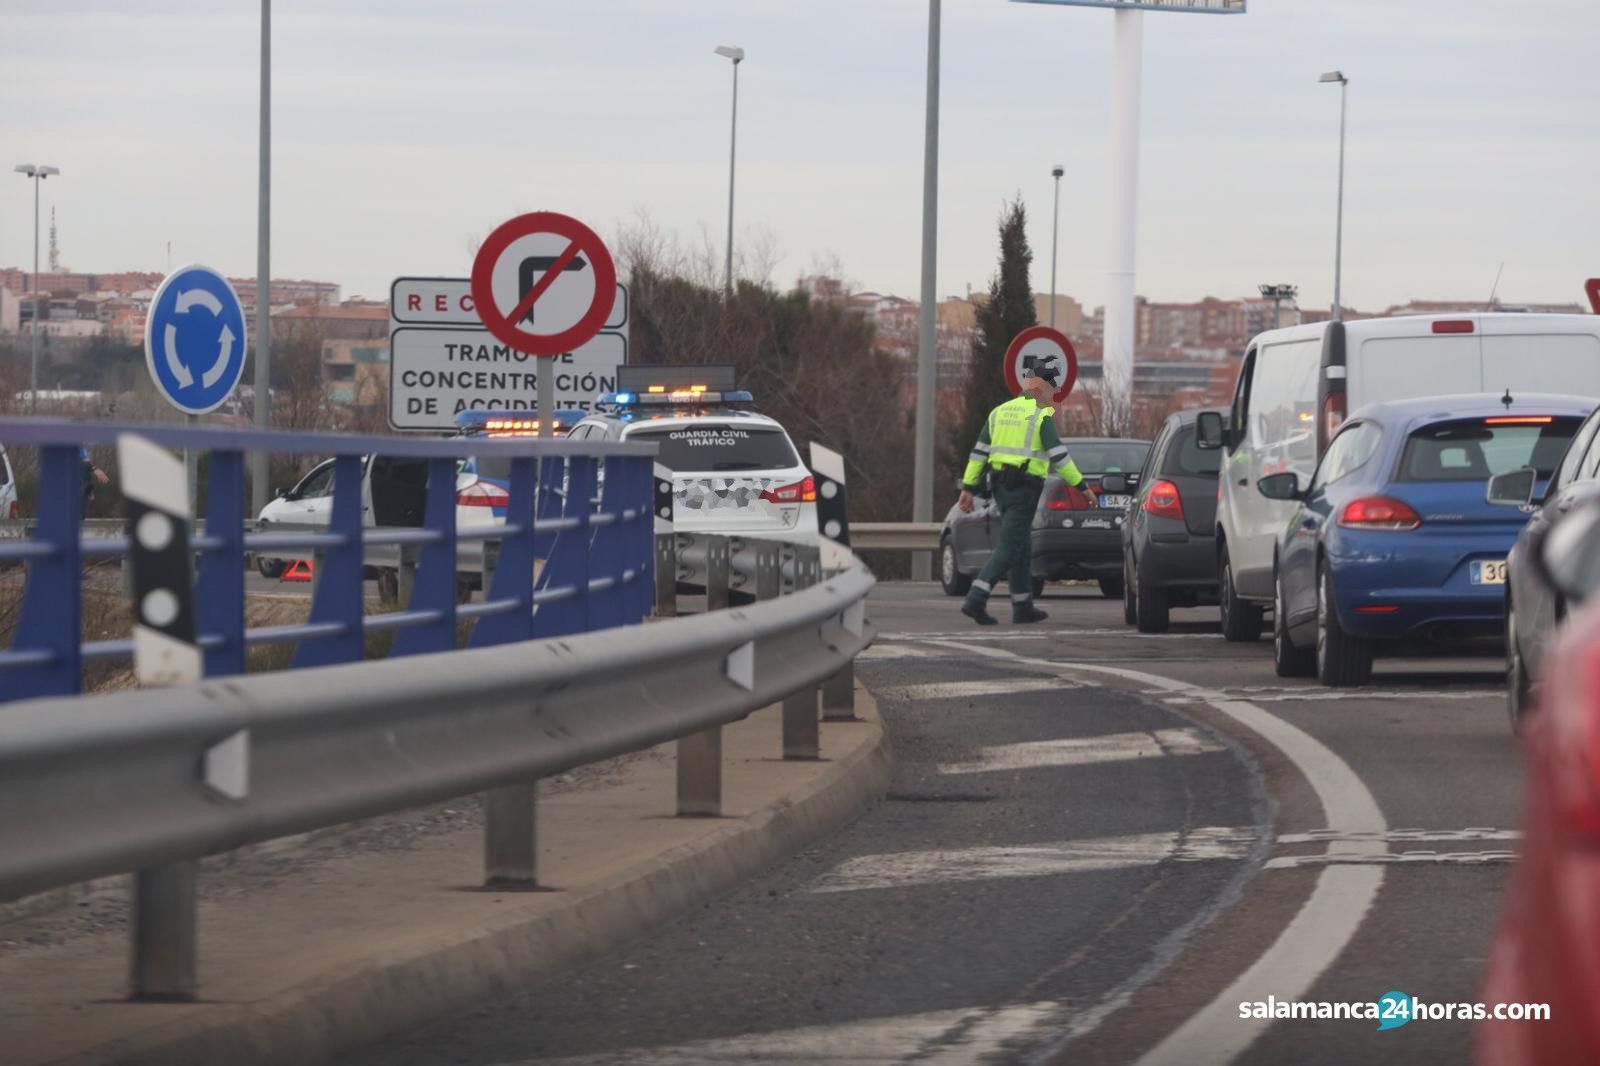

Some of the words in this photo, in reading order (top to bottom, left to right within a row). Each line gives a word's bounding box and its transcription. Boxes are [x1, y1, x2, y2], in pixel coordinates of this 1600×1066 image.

[444, 343, 529, 363] TRAMO
[402, 370, 615, 393] CONCENTRCIÓN
[407, 397, 438, 415] DE
[453, 398, 608, 416] ACCIDTES
[669, 430, 719, 440] GUARDIA
[721, 430, 750, 439] CIVIL
